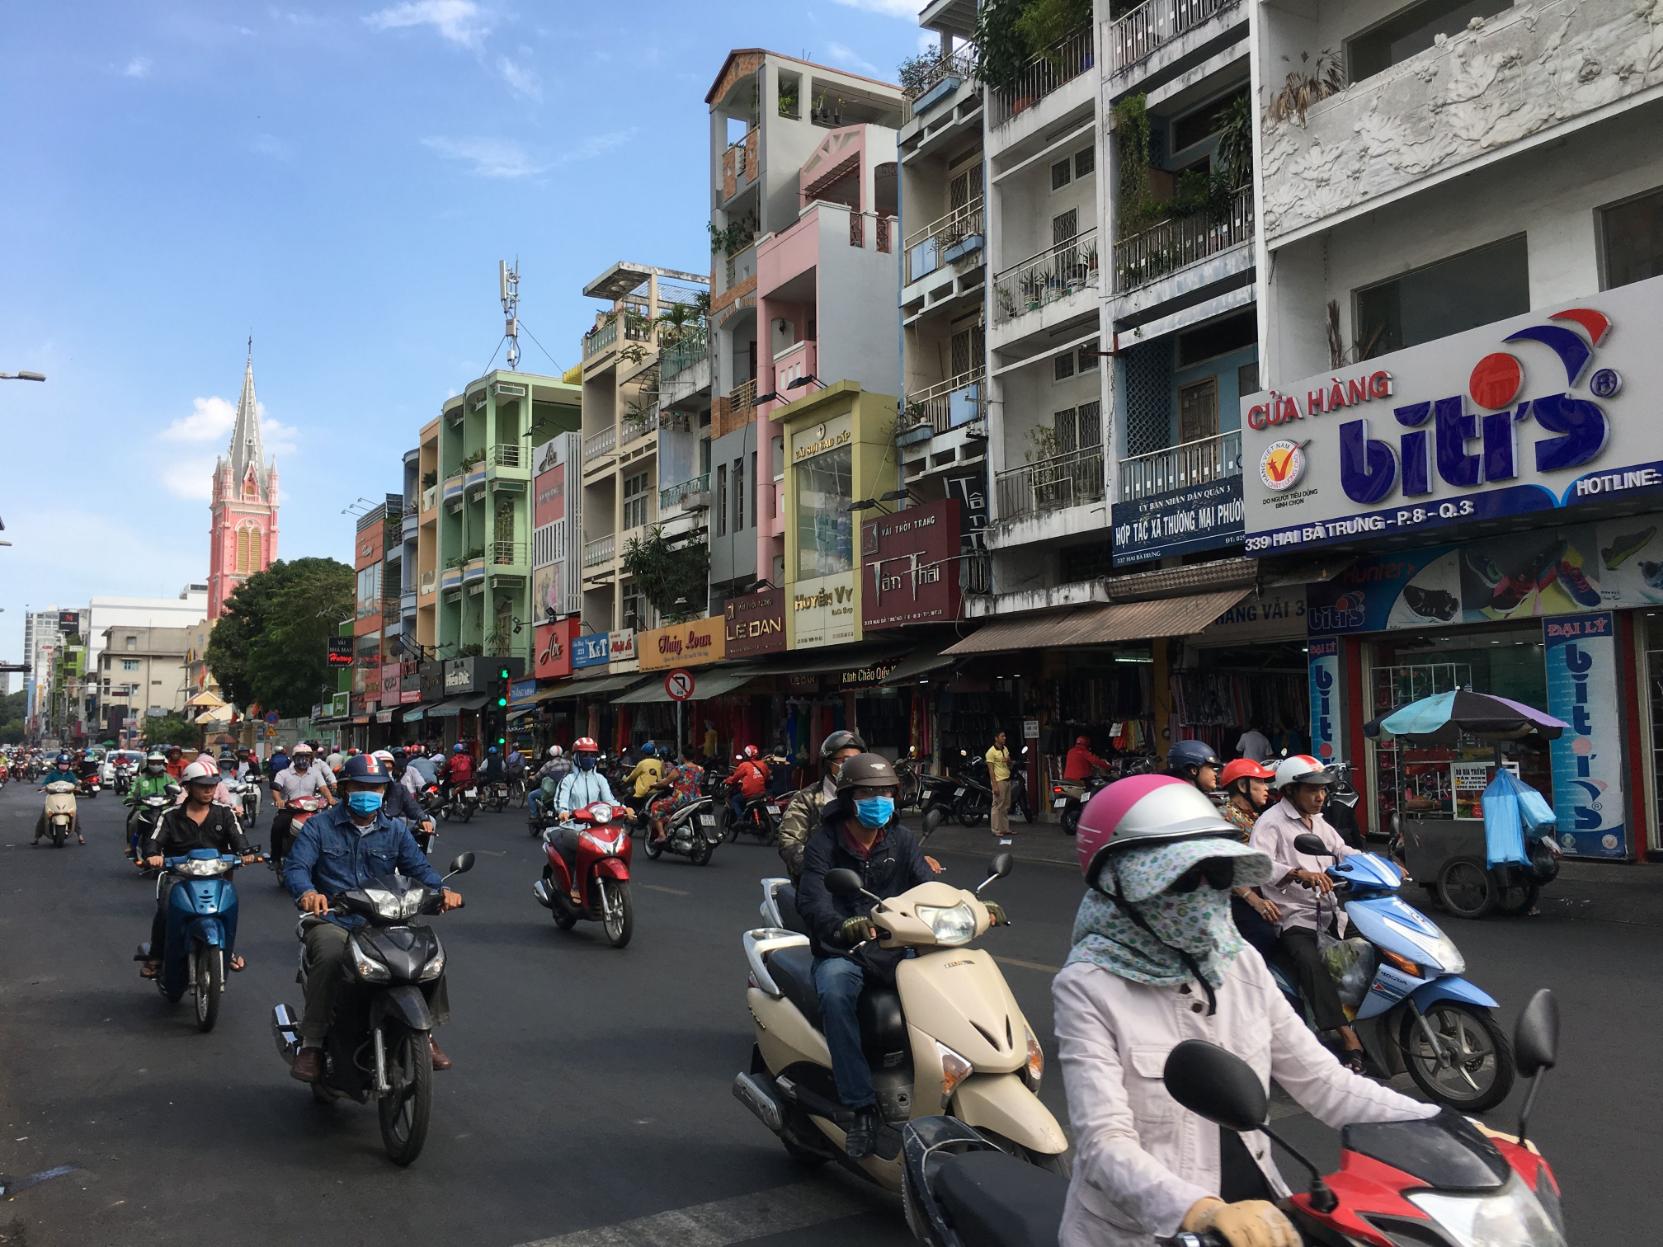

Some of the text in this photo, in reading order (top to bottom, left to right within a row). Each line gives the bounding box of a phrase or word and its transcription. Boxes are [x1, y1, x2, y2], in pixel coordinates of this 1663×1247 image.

[1247, 370, 1393, 430] CỬA HÀNG
[1339, 355, 1611, 505] biti's
[1115, 522, 1131, 549] HỢP
[1133, 517, 1149, 543] TÁC
[1151, 514, 1162, 539] XÃ
[1163, 510, 1195, 536] THƯƠNG
[1198, 506, 1215, 531] MẠI
[1245, 535, 1271, 551] 339
[1272, 529, 1300, 548] HAI
[1302, 521, 1328, 542] BÀ
[1327, 514, 1386, 539] TRƯNG
[1262, 597, 1289, 620] VẢI
